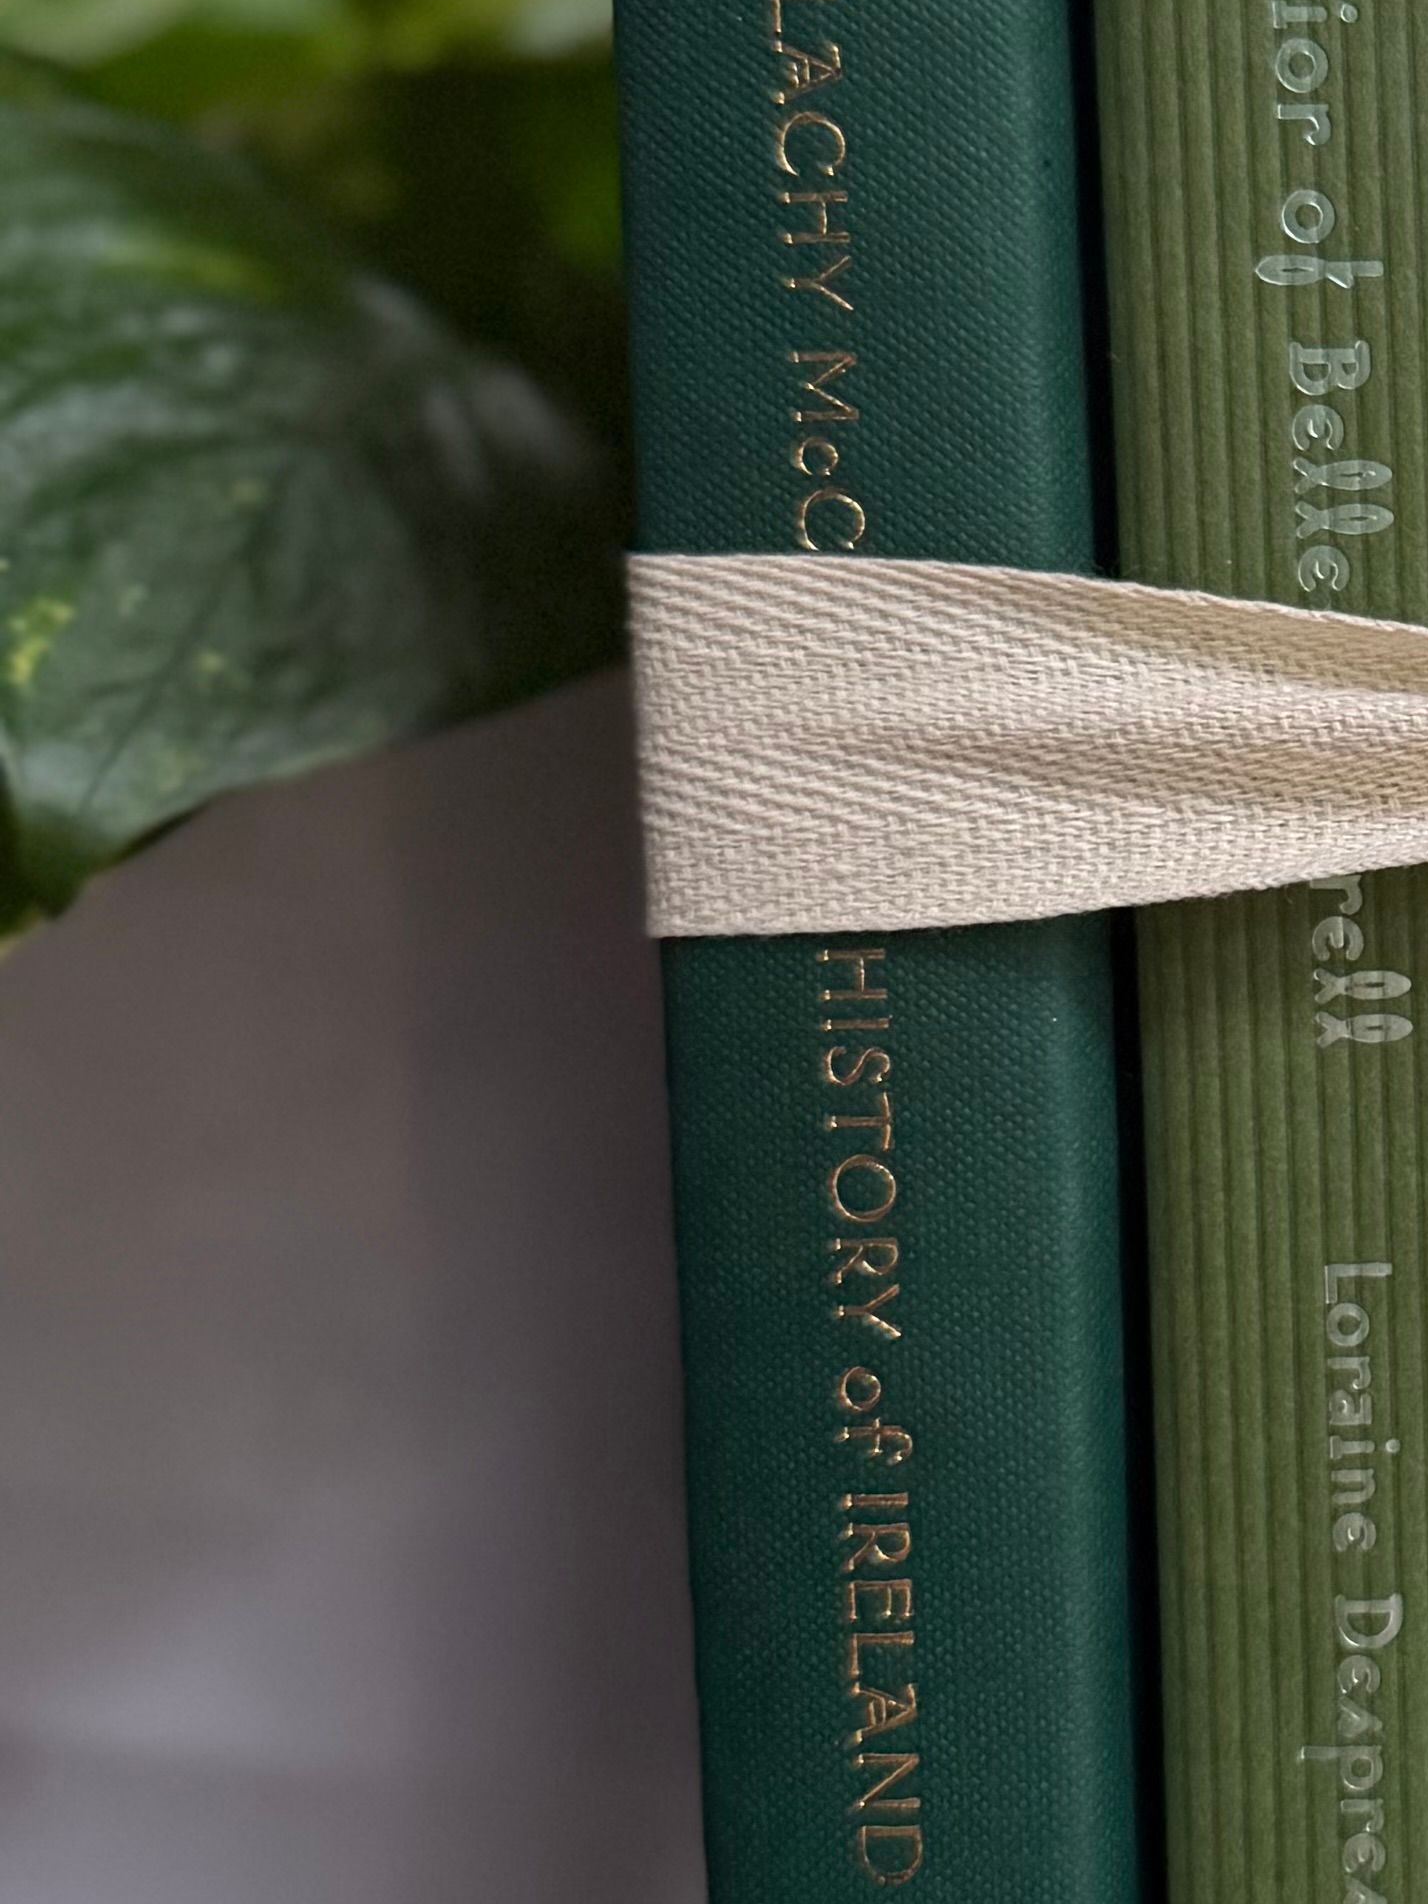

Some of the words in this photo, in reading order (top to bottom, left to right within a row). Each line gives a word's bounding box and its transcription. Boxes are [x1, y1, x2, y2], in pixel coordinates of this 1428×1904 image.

[1254, 188, 1385, 290] of
[1288, 339, 1395, 593] Belle
[1308, 874, 1414, 1047] rell
[816, 947, 902, 1339] HISTORY
[835, 1365, 913, 1466] of
[1323, 1261, 1401, 1553] Loraine
[842, 1491, 924, 1887] IRELAND
